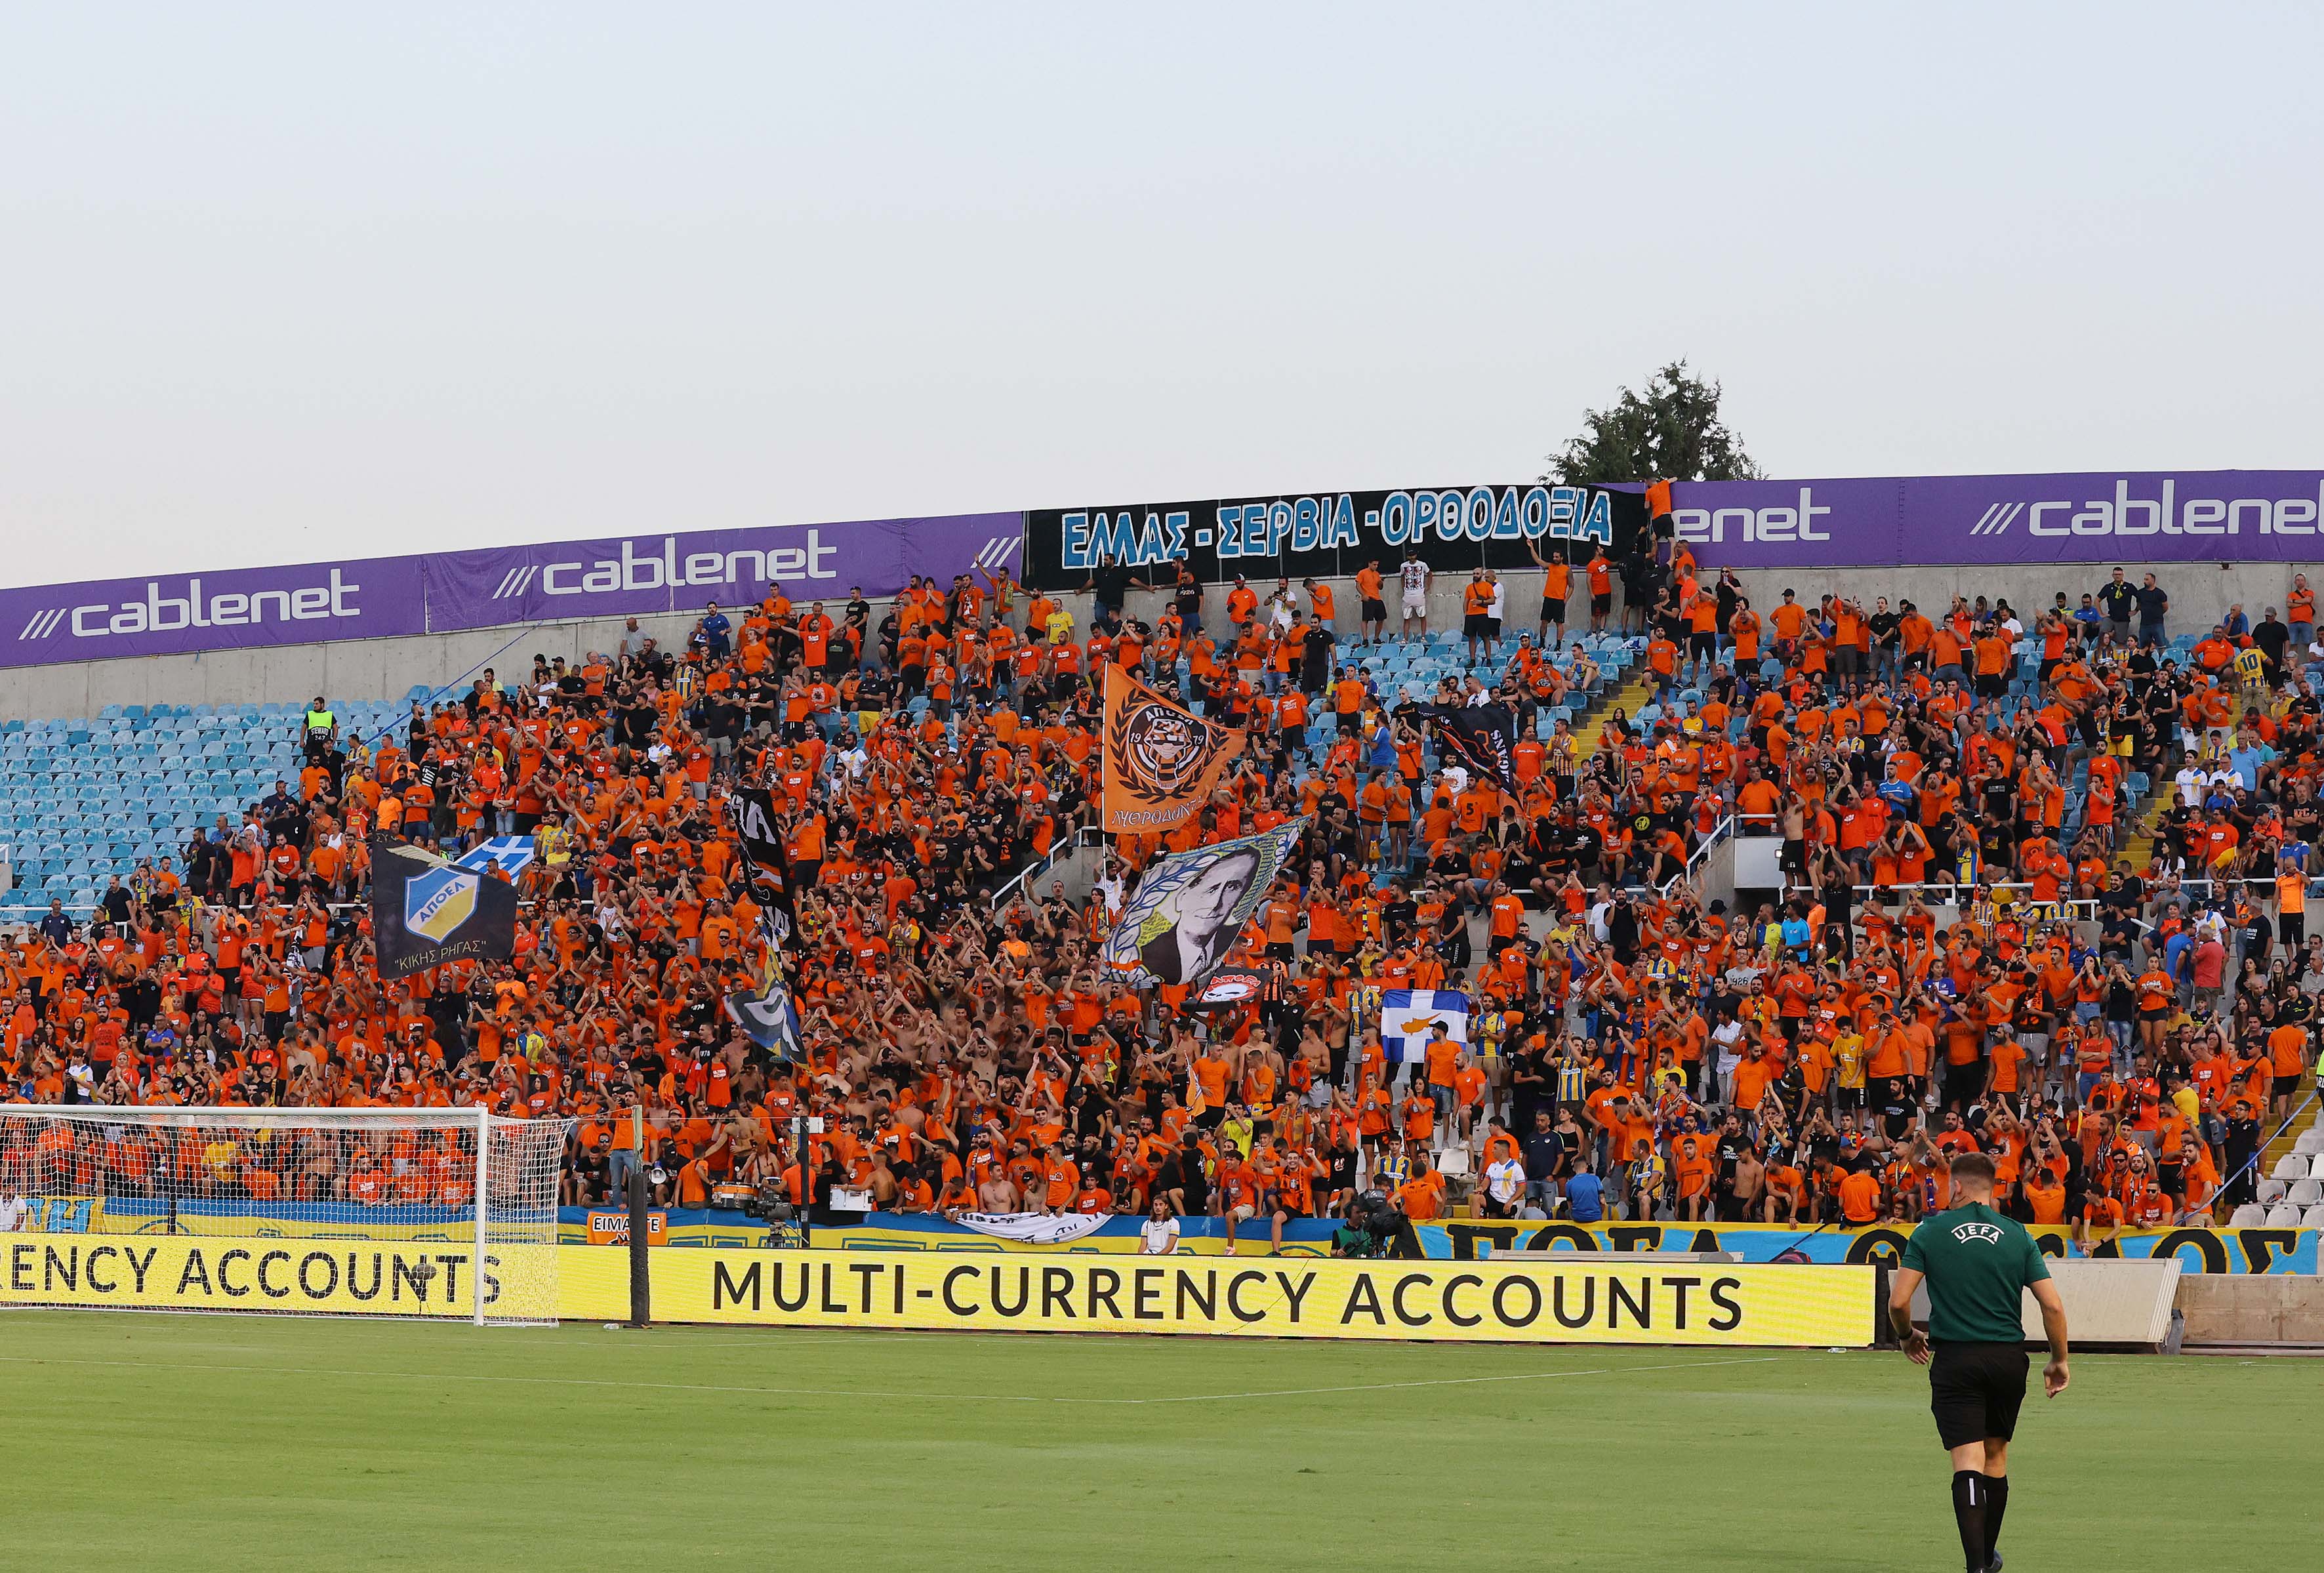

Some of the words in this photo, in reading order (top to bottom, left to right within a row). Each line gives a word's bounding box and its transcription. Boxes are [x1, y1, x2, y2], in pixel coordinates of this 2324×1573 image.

[1671, 487, 1831, 542] enet
[2029, 480, 2324, 535] cablene
[543, 530, 837, 594] cablenet
[71, 569, 360, 637] cablenet
[2240, 653, 2258, 672] 10
[1130, 732, 1141, 743] 19
[1193, 735, 1204, 745] 79
[419, 881, 466, 922] ΑΠΟΕΛ
[1953, 1225, 2001, 1243] UEFA
[0, 1244, 158, 1293] ENCY
[176, 1248, 501, 1305] ACCOUNTS
[714, 1259, 1317, 1324] MULTI-CURRENCY
[1341, 1271, 1742, 1332] ACCOUNTS
